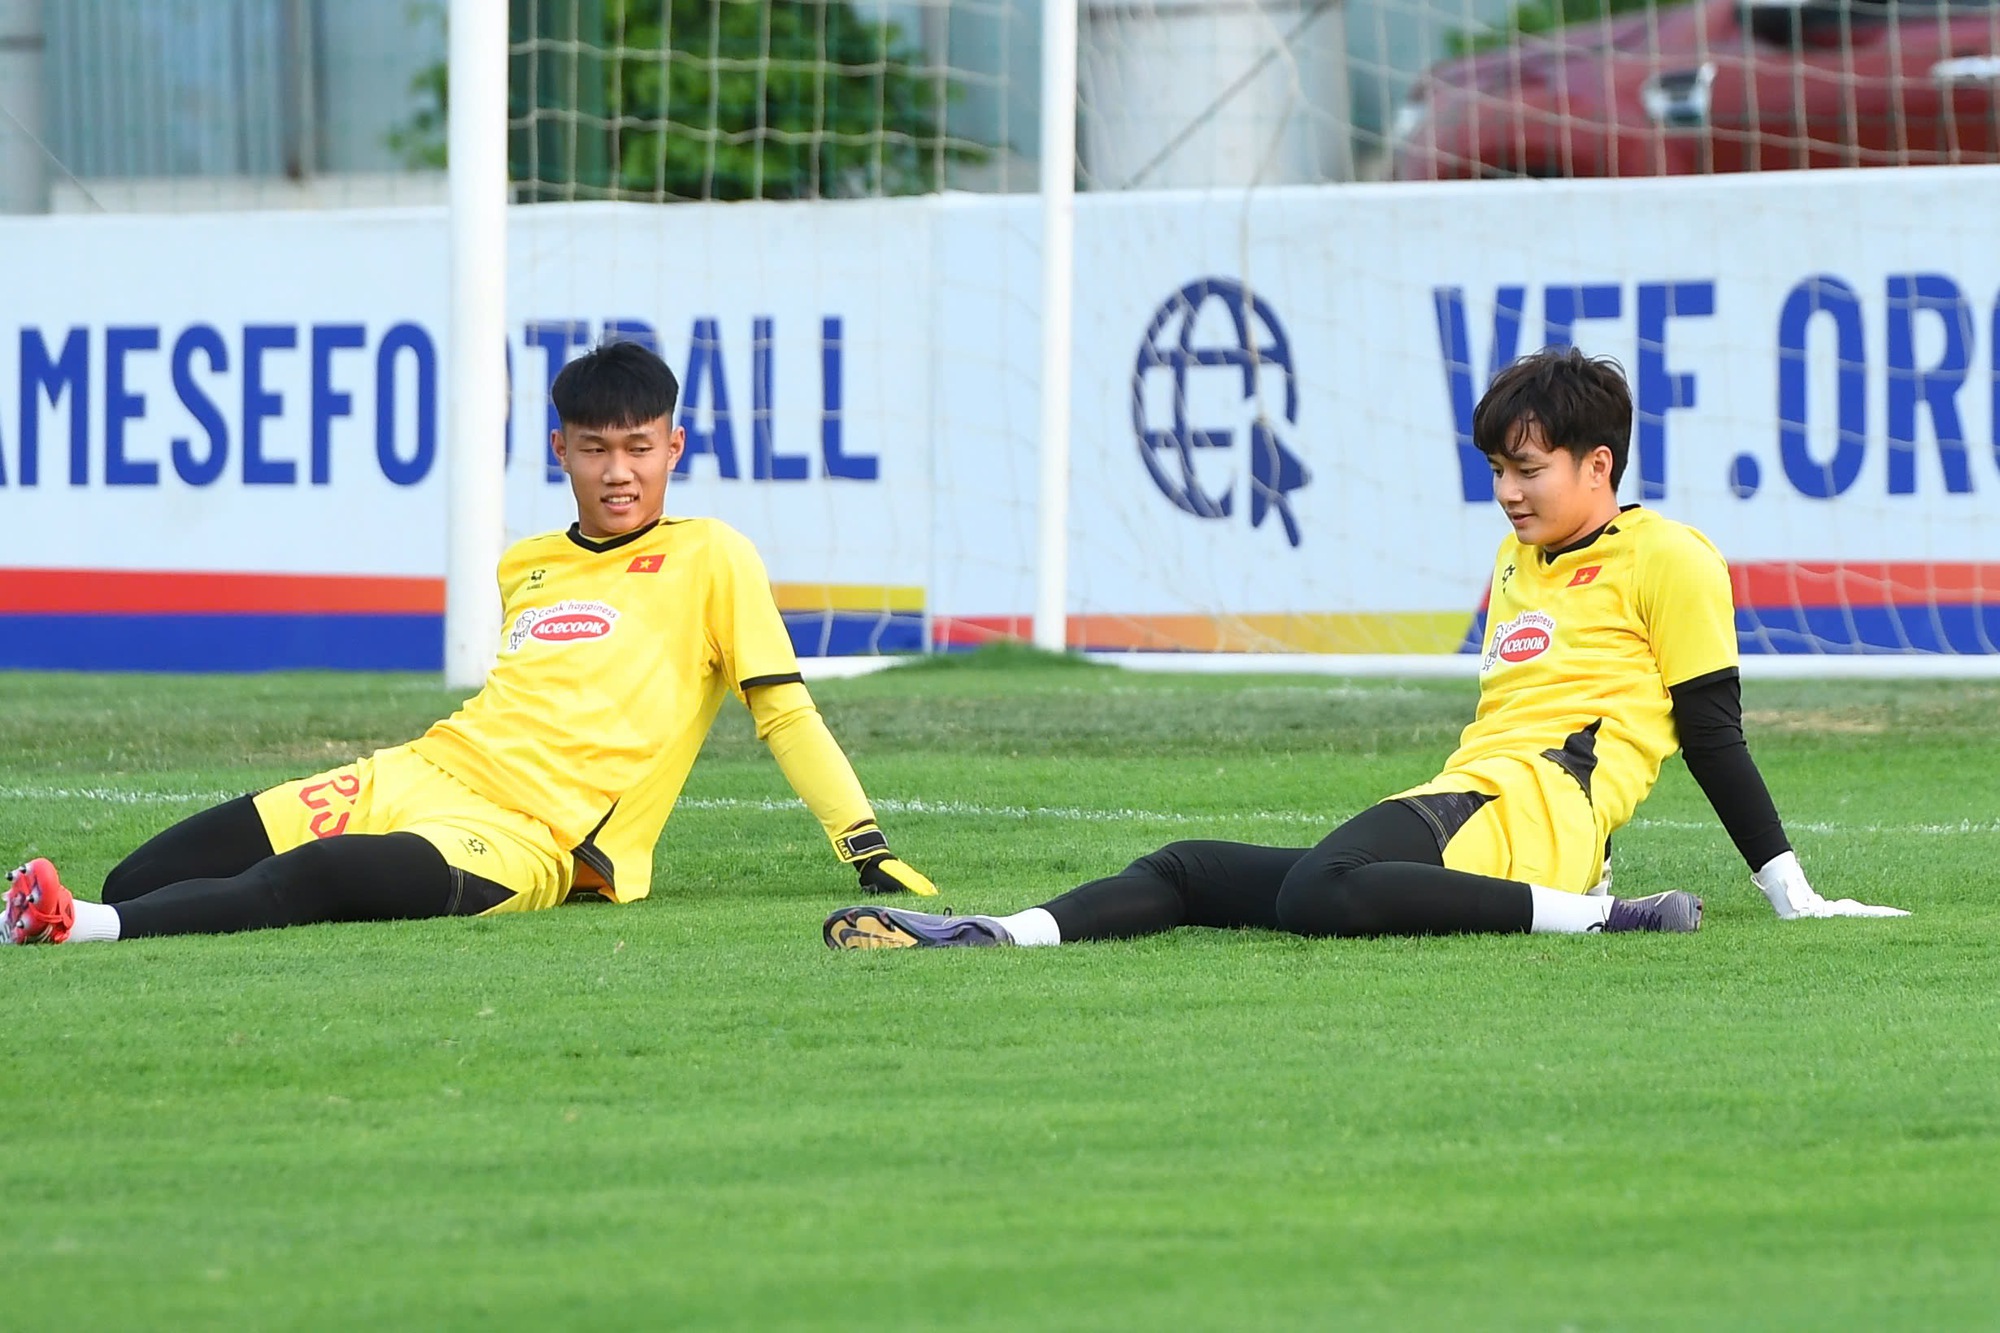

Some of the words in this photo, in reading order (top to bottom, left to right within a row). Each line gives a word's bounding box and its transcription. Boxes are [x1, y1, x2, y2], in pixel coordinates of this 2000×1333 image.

[0, 315, 879, 487] MESEFOTALL
[1433, 271, 2000, 502] VF.OR
[539, 602, 564, 618] Cook
[568, 601, 617, 619] happiness
